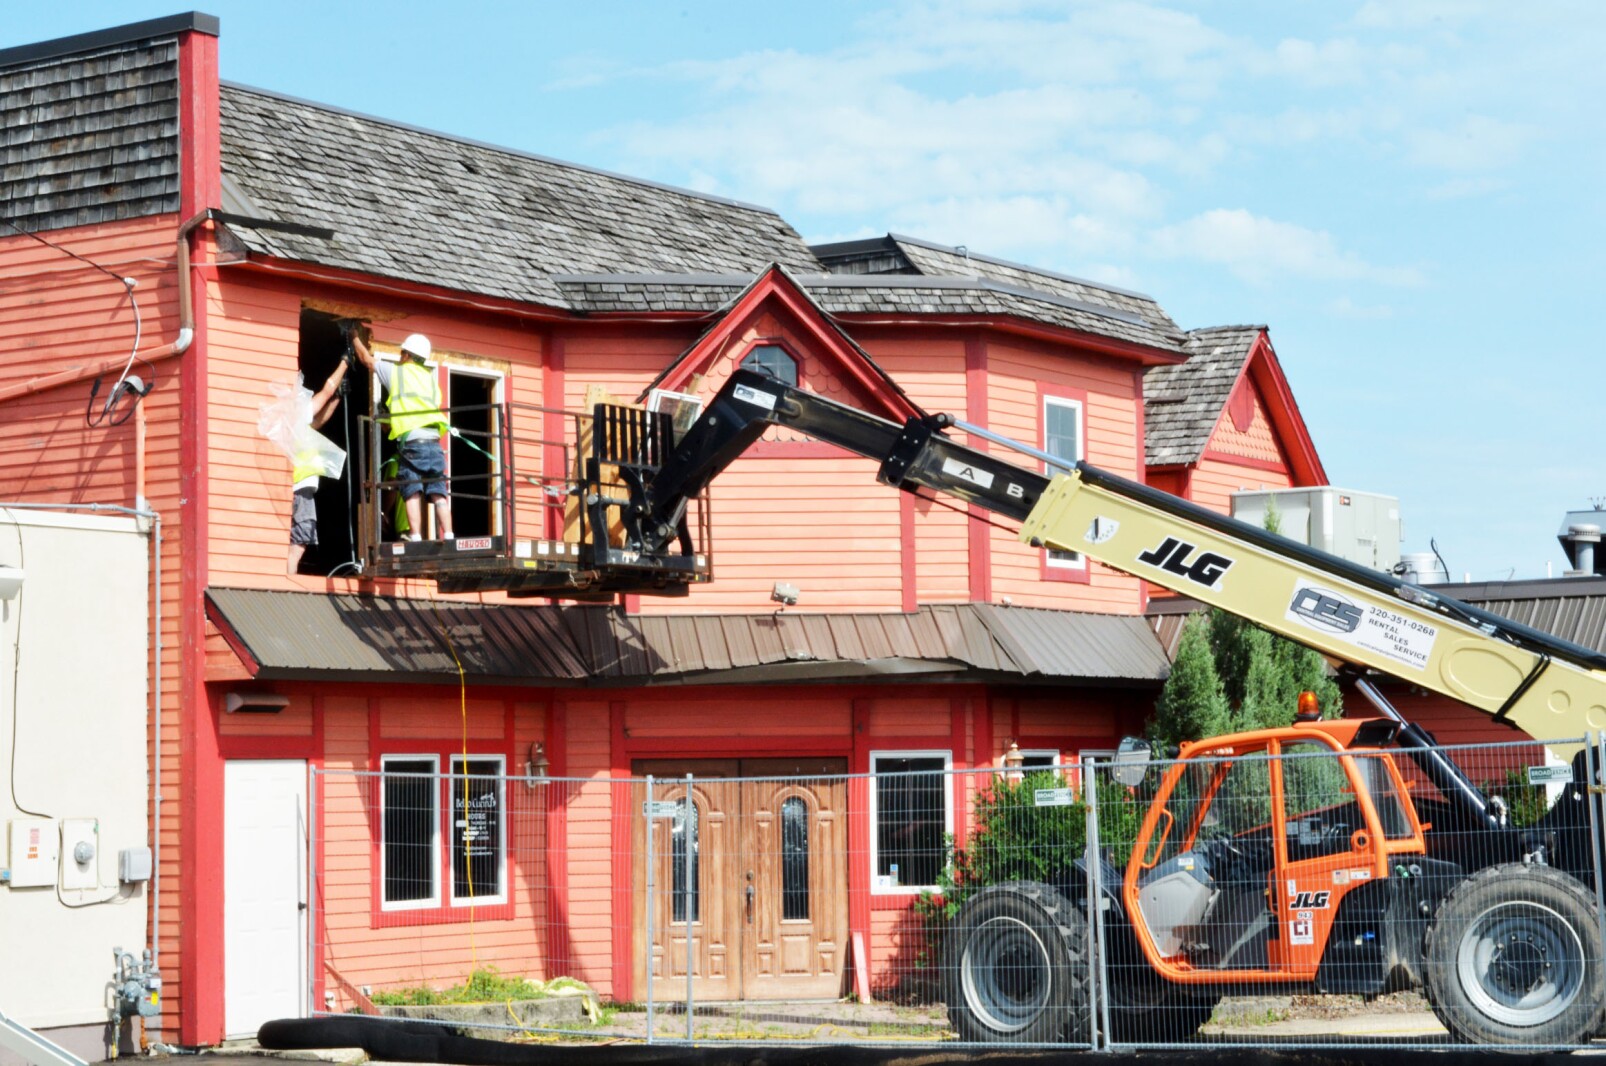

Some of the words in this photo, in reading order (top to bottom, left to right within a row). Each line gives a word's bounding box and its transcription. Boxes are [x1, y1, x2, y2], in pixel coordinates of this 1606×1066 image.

[959, 467, 975, 480] A
[1006, 482, 1024, 498] B
[1137, 537, 1233, 587] JLG
[1290, 588, 1364, 632] CES
[1368, 618, 1399, 634] RENTAL
[1370, 606, 1435, 636] 320-351-0268
[1384, 632, 1409, 646] SALES
[1393, 644, 1428, 661] SERVICE
[1290, 892, 1329, 909] JLG
[1298, 911, 1312, 919] 943
